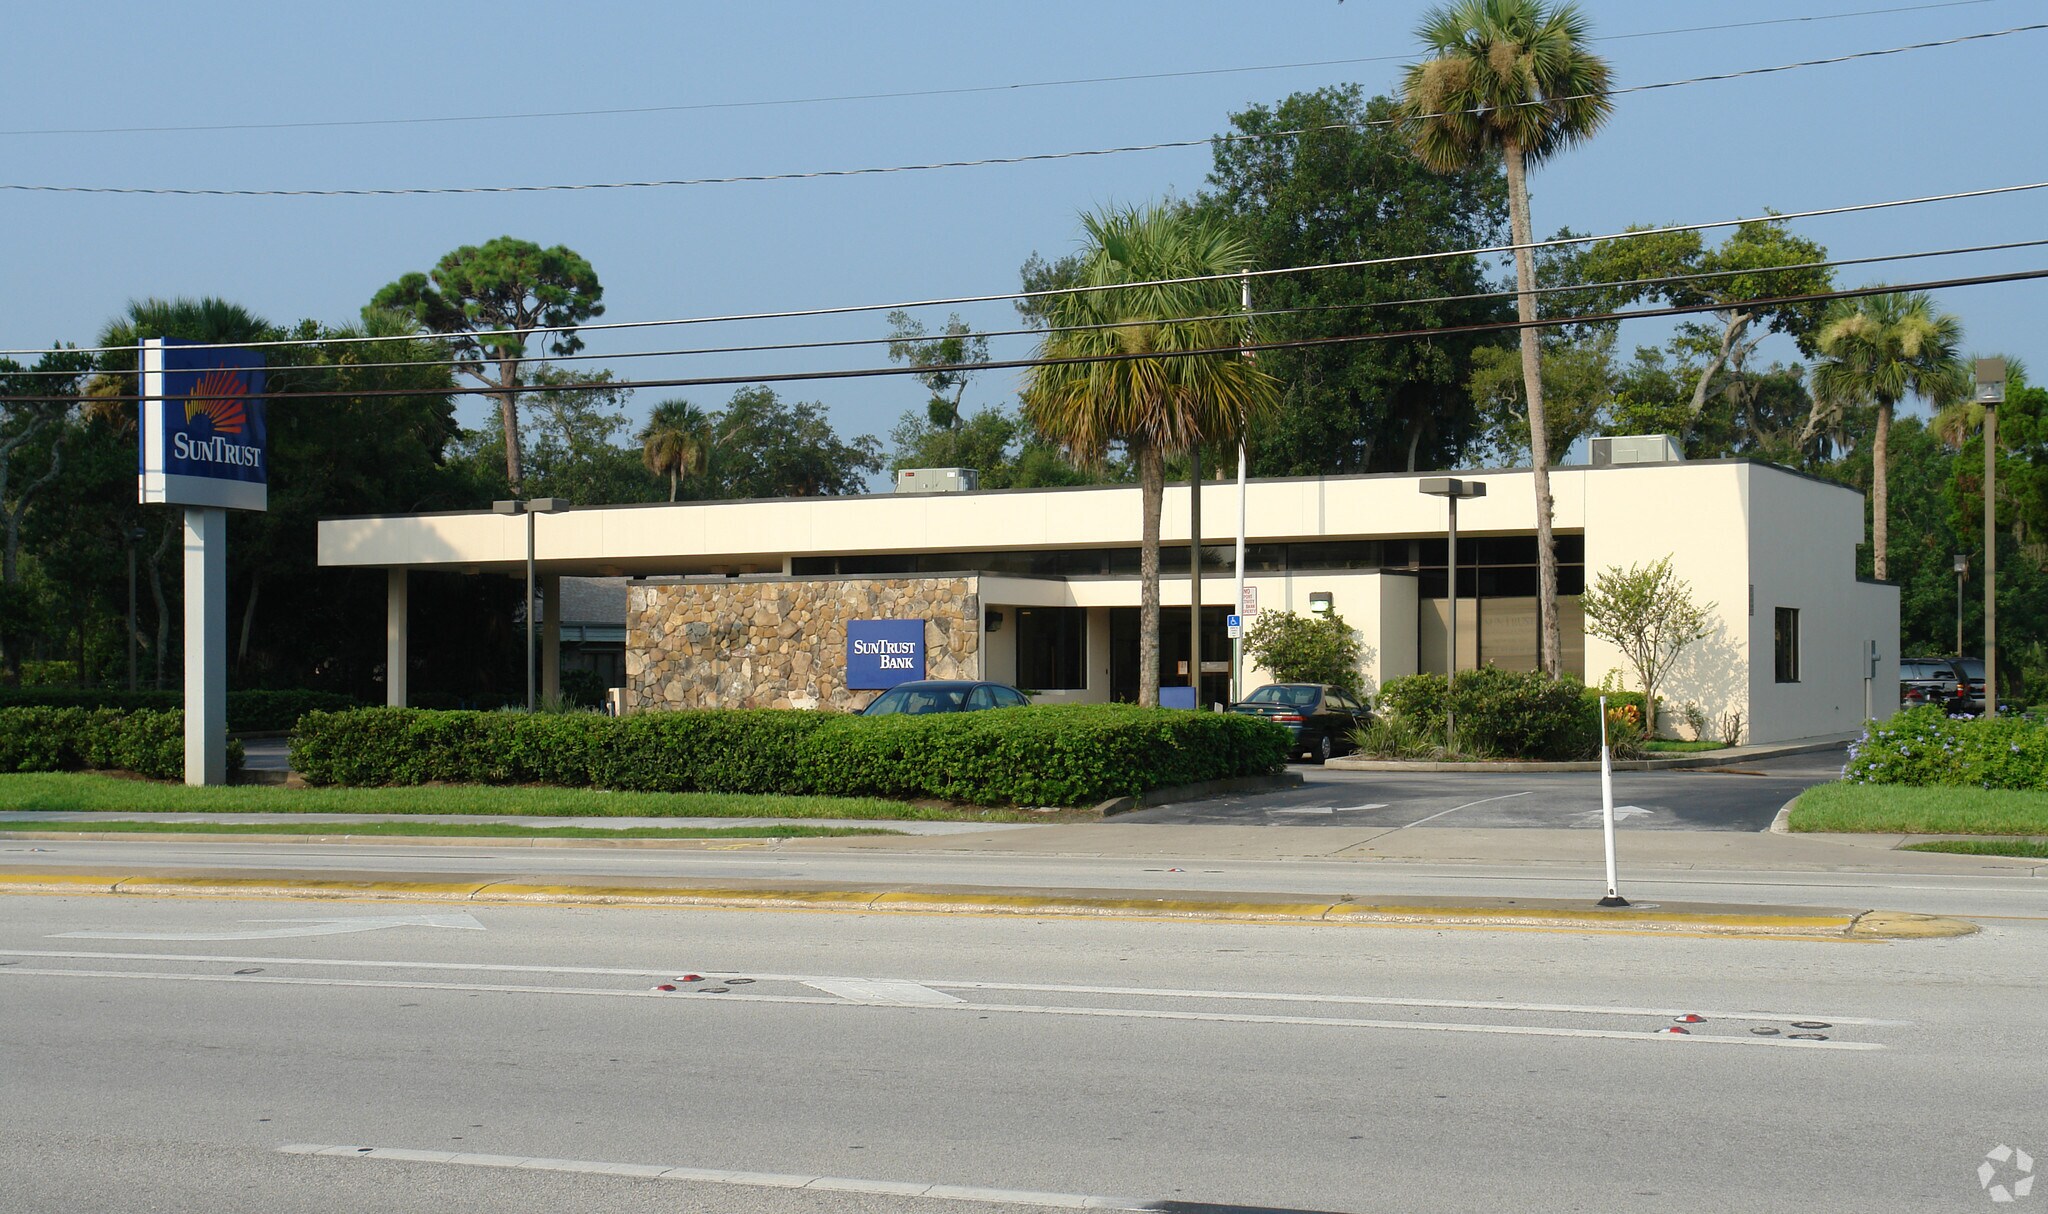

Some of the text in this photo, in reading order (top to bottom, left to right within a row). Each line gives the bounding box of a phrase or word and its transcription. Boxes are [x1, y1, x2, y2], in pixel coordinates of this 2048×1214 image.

[174, 432, 261, 467] SUNTRUST
[854, 639, 916, 654] SUNTRUST
[880, 654, 914, 669] BANK
